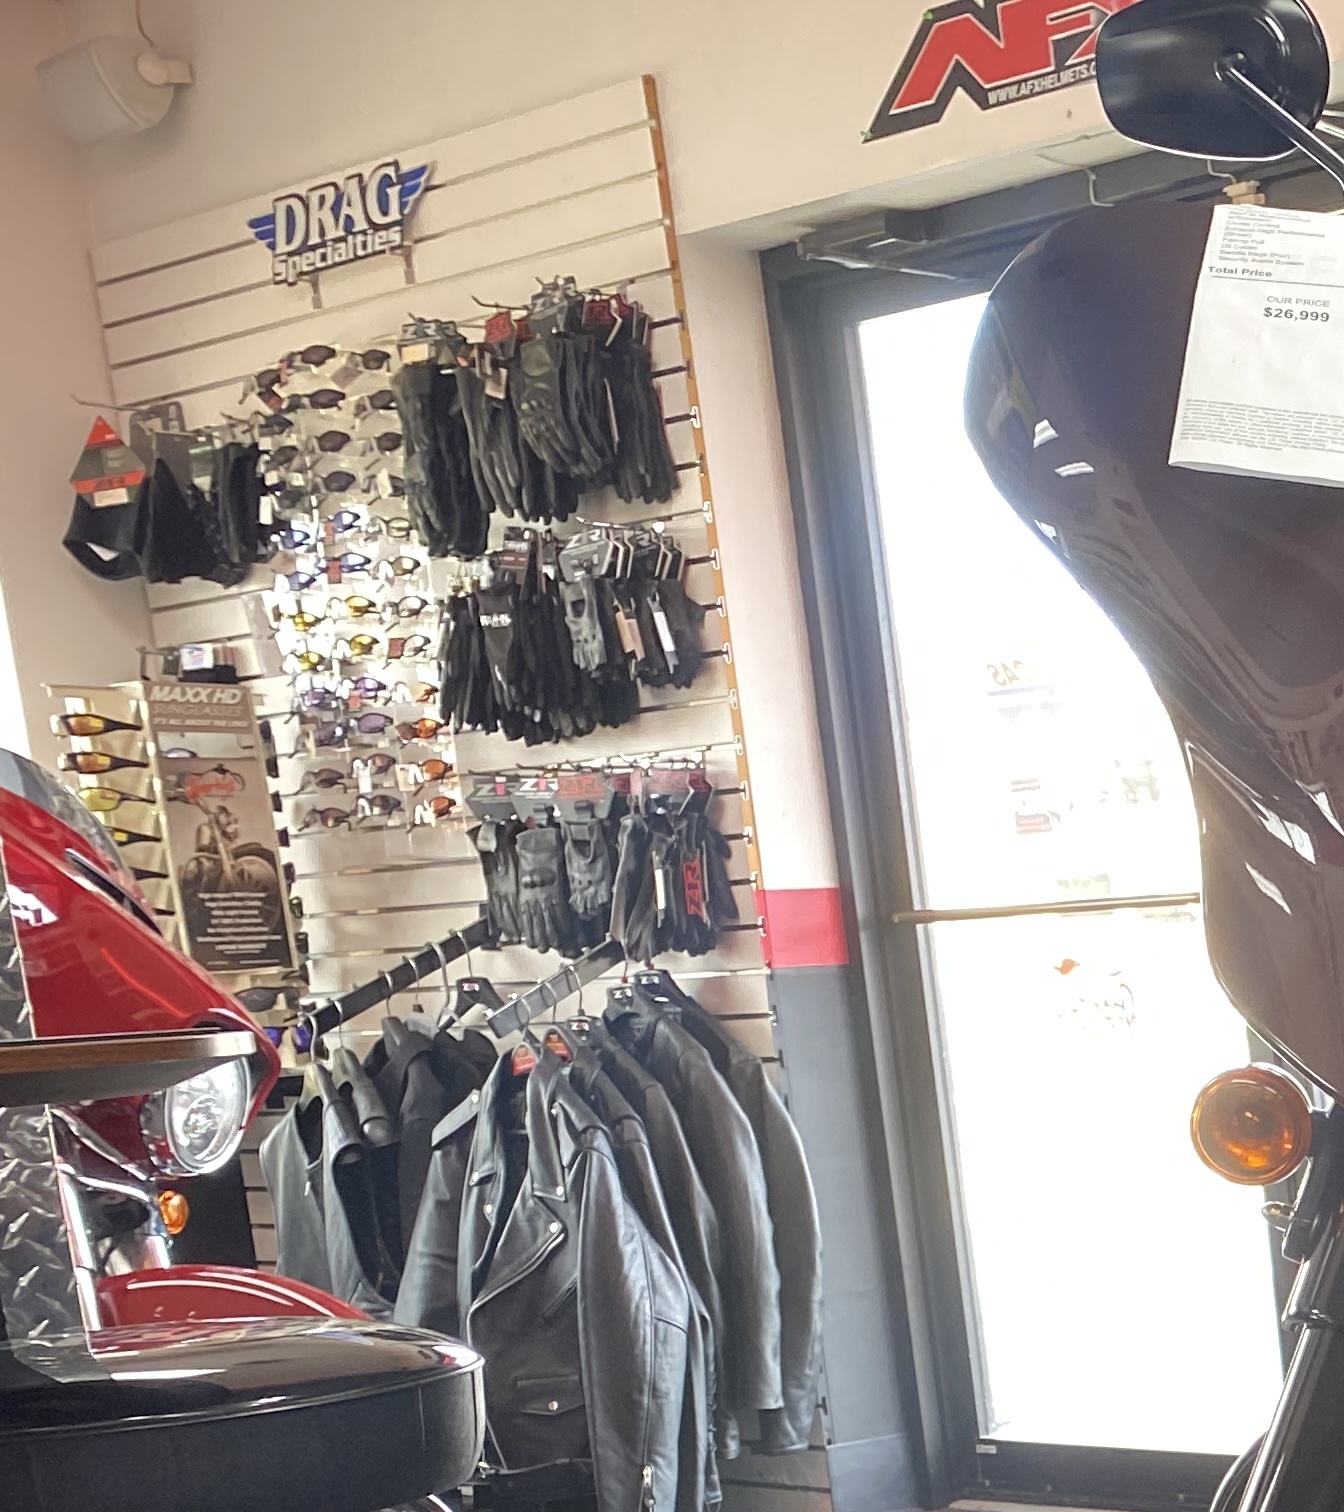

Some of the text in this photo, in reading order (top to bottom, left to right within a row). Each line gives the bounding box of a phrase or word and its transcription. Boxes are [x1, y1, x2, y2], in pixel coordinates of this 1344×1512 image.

[986, 62, 1097, 105] WWW.AFXHELMETS.C
[272, 162, 404, 255] DRAG
[273, 227, 402, 284] Specialties
[1208, 266, 1238, 275] Total
[1241, 268, 1273, 278] Price
[1266, 296, 1331, 308] OUR PRICE
[1262, 307, 1330, 322] $26,999
[149, 685, 242, 704] MAXX HD
[152, 703, 244, 717] SUNGLASSES
